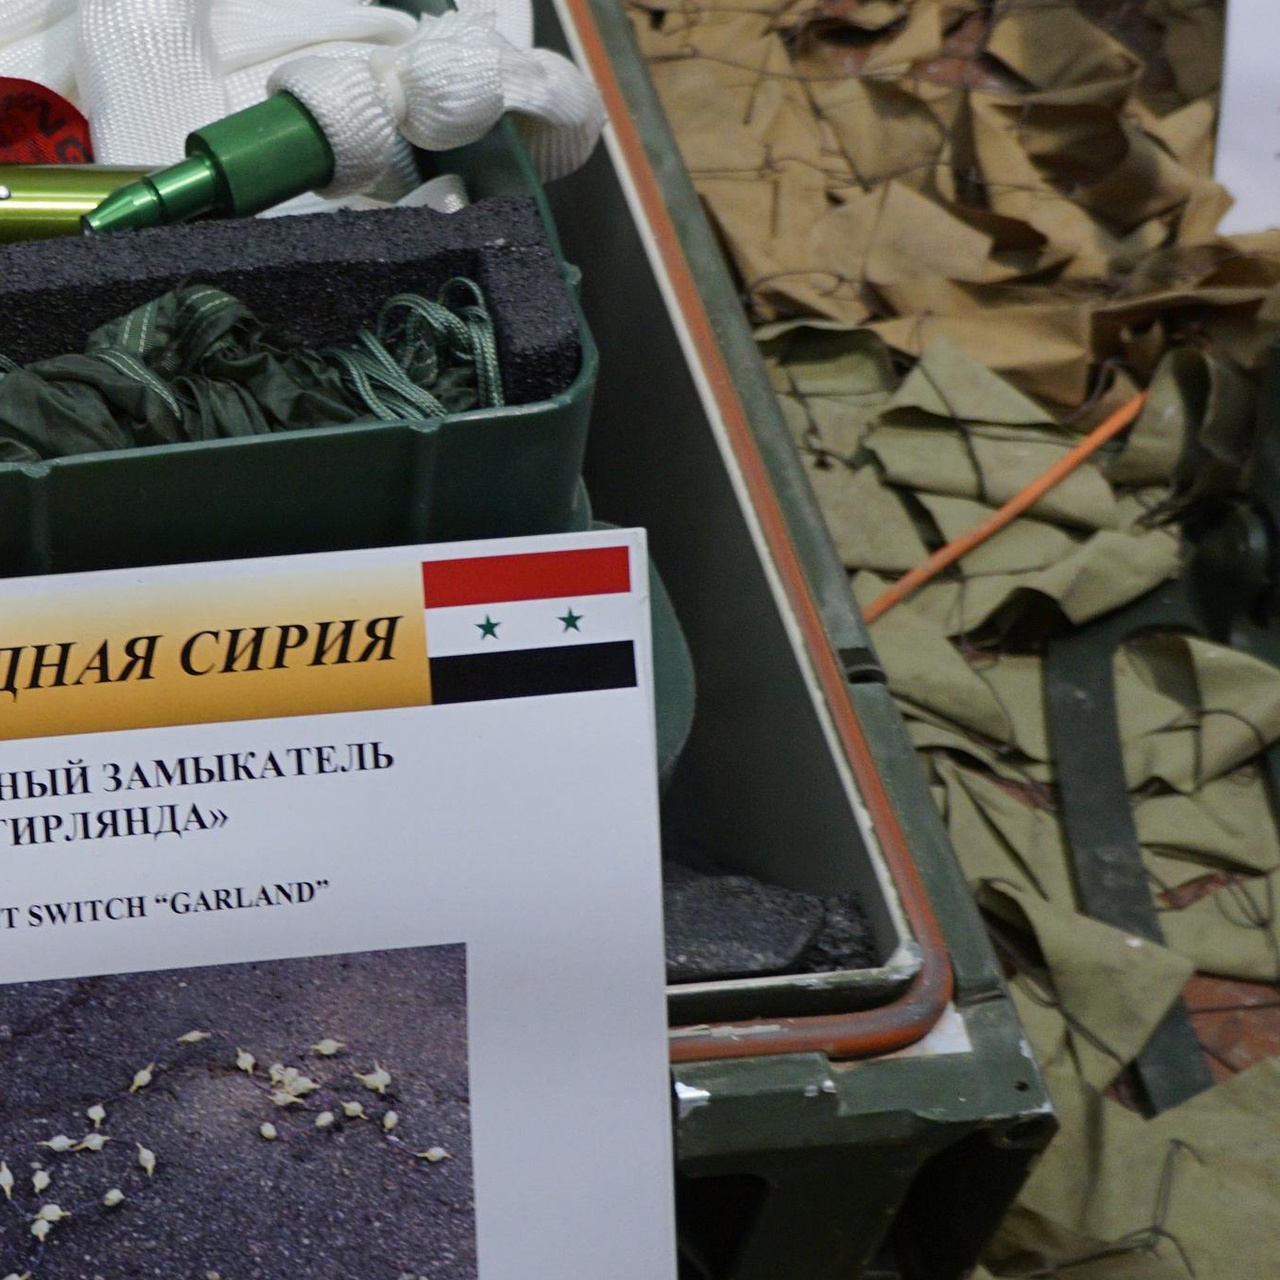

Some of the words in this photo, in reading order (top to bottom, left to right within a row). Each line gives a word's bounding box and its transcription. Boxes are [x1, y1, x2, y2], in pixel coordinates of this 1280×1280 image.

[181, 616, 401, 677] СИРИЯ
[102, 741, 395, 790] ЗАМЫКАТЕЛЬ
[28, 896, 147, 927] SWITCH
